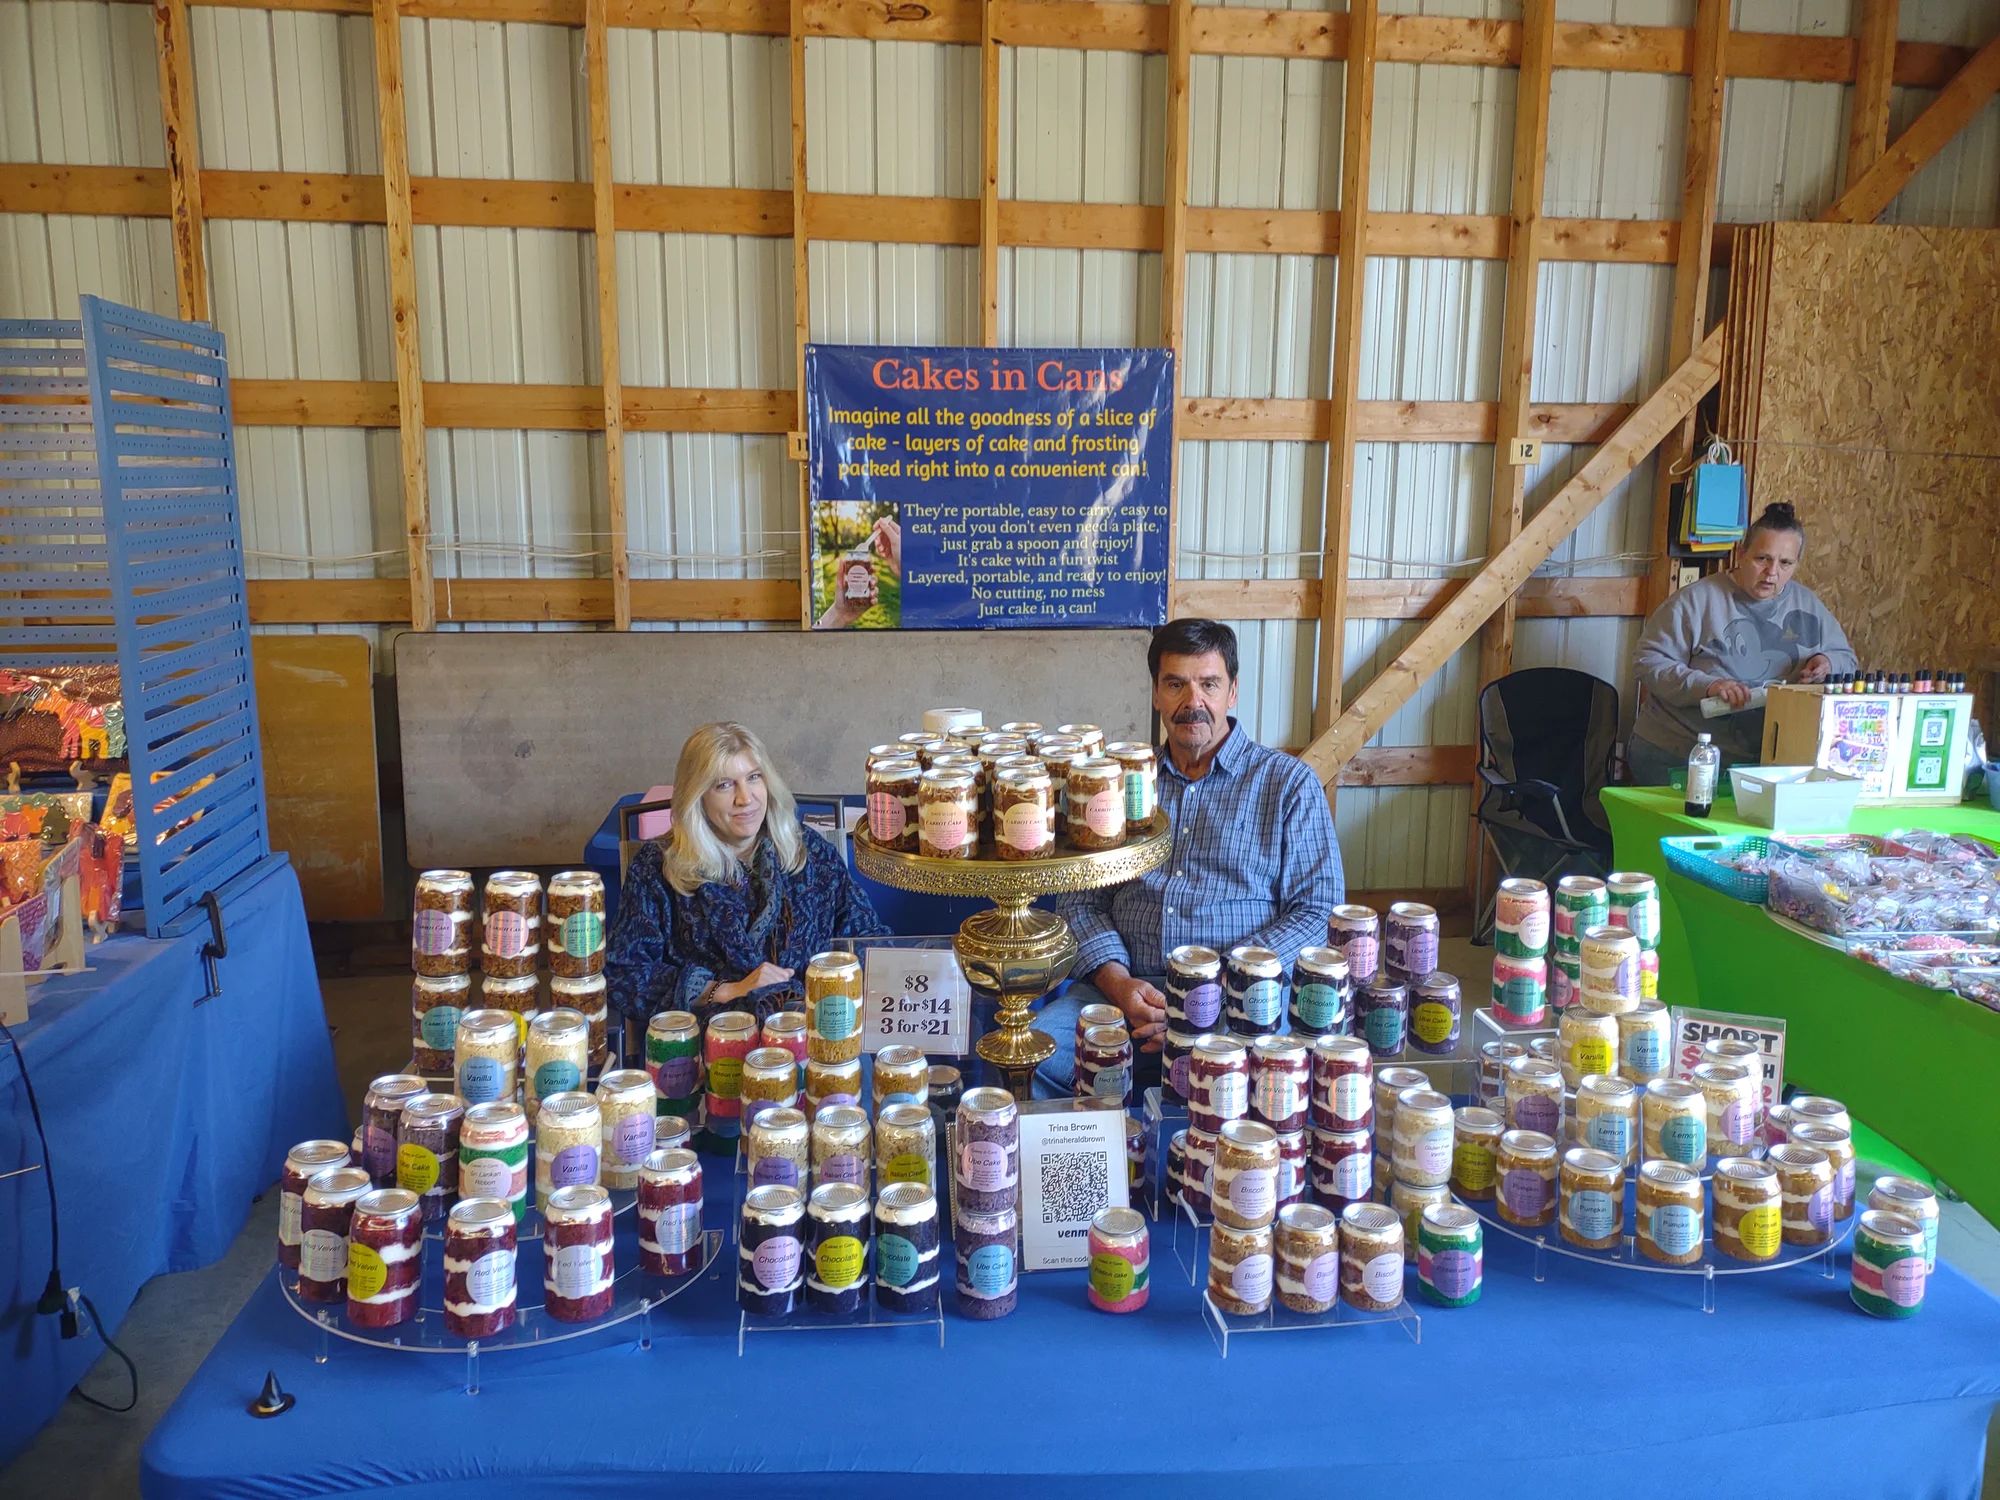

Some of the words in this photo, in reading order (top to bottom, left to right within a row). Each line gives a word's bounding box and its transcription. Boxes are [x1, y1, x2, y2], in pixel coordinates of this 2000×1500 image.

[872, 358, 980, 391] Cakes
[990, 359, 1027, 391] in
[1037, 360, 1124, 392] Cans
[828, 406, 900, 429] Imagine
[906, 407, 930, 425] all
[935, 408, 964, 425] the
[970, 408, 1051, 430] goodness
[1056, 409, 1075, 430] of
[1079, 413, 1090, 425] a
[1096, 409, 1133, 425] slice
[1139, 408, 1157, 429] of
[847, 433, 887, 450] cake
[905, 433, 960, 455] layers
[965, 434, 984, 455] of
[989, 434, 1028, 451] cake
[1033, 434, 1066, 451] and
[1071, 434, 1139, 455] frosting
[838, 459, 901, 480] packed
[906, 460, 949, 481] right
[954, 460, 989, 477] into
[994, 464, 1005, 477] a
[1010, 460, 1107, 477] convenient
[1112, 460, 1147, 477] can!
[904, 503, 958, 520] They're
[962, 503, 1024, 520] portable,
[1028, 506, 1058, 519] easy
[1061, 505, 1075, 516] to
[1080, 506, 1117, 518] carry,
[1121, 505, 1149, 518] easy
[1153, 504, 1167, 516] to
[912, 523, 936, 535] eat,
[940, 520, 966, 534] and
[970, 523, 996, 537] you
[1000, 519, 1035, 533] don't
[1039, 522, 1072, 533] even
[1076, 520, 1108, 532] need
[1112, 523, 1119, 532] a
[1123, 519, 1160, 535] plate,
[940, 537, 967, 553] just
[971, 536, 1002, 553] grab
[1006, 541, 1013, 550] a
[1017, 540, 1059, 553] spoon
[1063, 536, 1088, 549] and
[1092, 535, 1133, 552] enjoy!
[958, 553, 977, 567] It's
[981, 553, 1011, 566] cake
[1016, 552, 1045, 566] with
[1049, 556, 1057, 566] a
[1061, 553, 1083, 566] fun
[1087, 552, 1118, 565] twist
[908, 570, 968, 587] Layered,
[972, 569, 1034, 587] portable,
[1038, 569, 1062, 583] and
[1067, 569, 1104, 585] ready
[1108, 571, 1121, 581] to
[1125, 568, 1166, 584] enjoy!
[971, 586, 992, 599] No
[995, 586, 1046, 601] cutting,
[1051, 588, 1068, 598] no
[1072, 588, 1105, 597] mess
[977, 602, 1005, 619] Just
[1008, 601, 1037, 615] cake
[1041, 601, 1054, 613] in
[1058, 605, 1066, 613] a
[1069, 601, 1097, 613] can!
[905, 975, 928, 993] $8
[882, 997, 895, 1012] 2
[899, 998, 920, 1012] for
[922, 998, 952, 1014] $14
[880, 1018, 893, 1034] 3
[897, 1019, 919, 1033] for
[921, 1019, 950, 1035] $21
[467, 1074, 492, 1082] Vanilla
[543, 1078, 569, 1086] Vanilla
[1048, 1124, 1069, 1132] Trina
[1070, 1123, 1098, 1131] Brown
[1598, 1127, 1624, 1136] Lemon
[623, 1130, 648, 1142] Vanilla
[1041, 1135, 1106, 1146] @trinaheraldbrown
[562, 1164, 588, 1174] Vanilla
[983, 1159, 1001, 1167] Cake
[1058, 1228, 1088, 1239] venm
[758, 1252, 797, 1264] Chocolate
[820, 1253, 859, 1263] Chocolate
[1061, 1255, 1073, 1263] this
